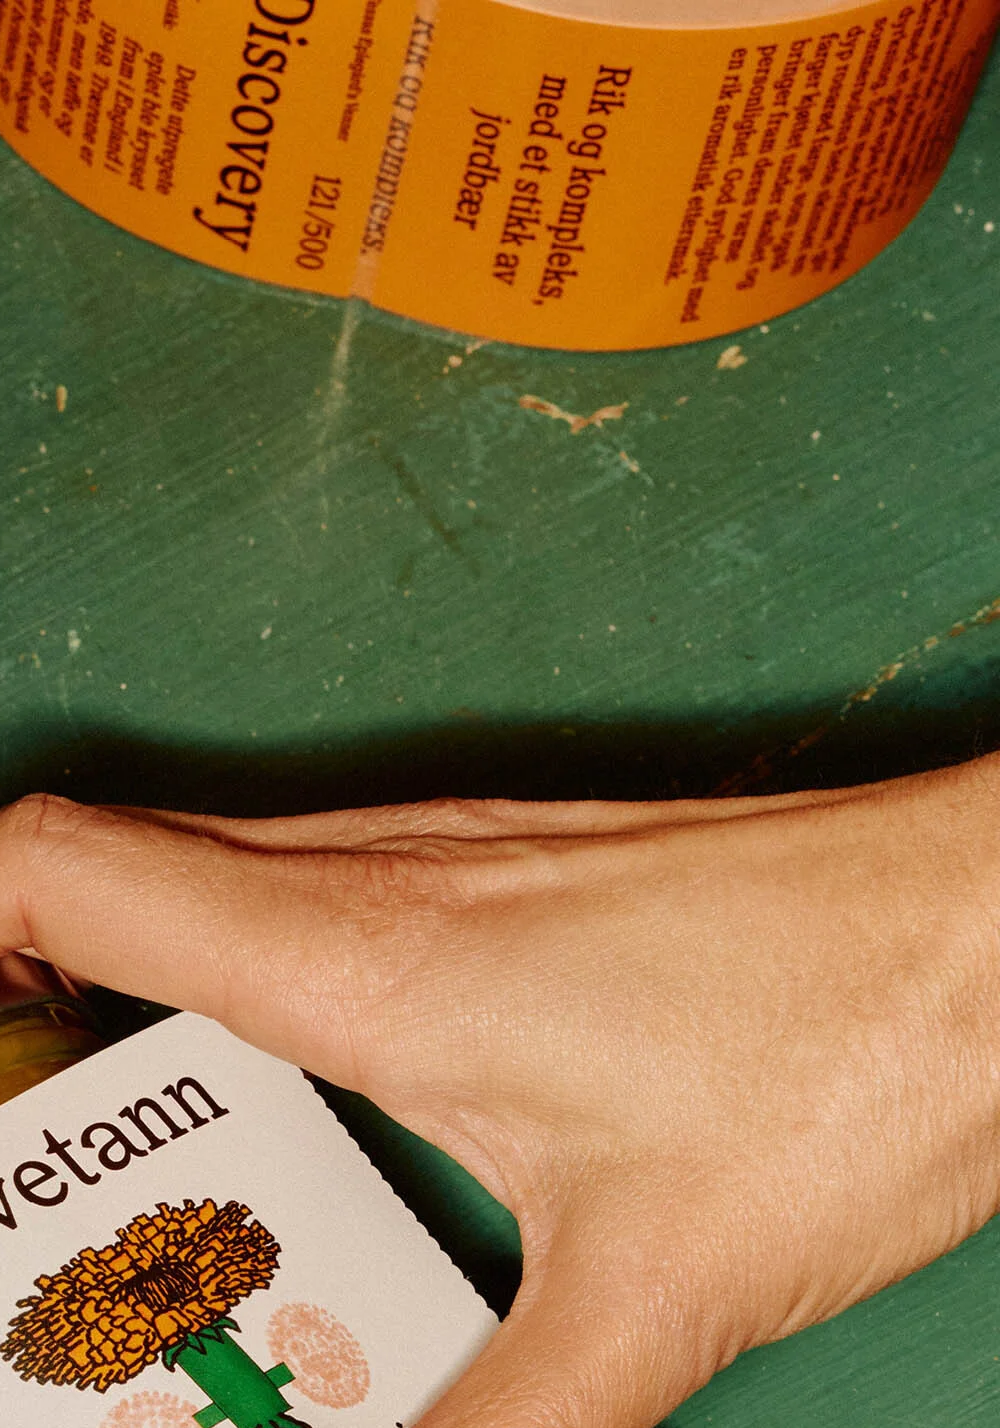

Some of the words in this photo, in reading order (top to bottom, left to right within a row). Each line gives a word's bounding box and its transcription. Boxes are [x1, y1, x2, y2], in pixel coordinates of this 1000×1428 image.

[527, 73, 567, 141] med
[586, 64, 632, 116] Rik
[192, 0, 315, 252] Discovery
[518, 144, 550, 174] et
[565, 122, 607, 160] og
[453, 107, 511, 231] jordbær
[499, 177, 542, 246] stikk
[531, 164, 606, 308] kompleks,
[492, 251, 519, 286] av
